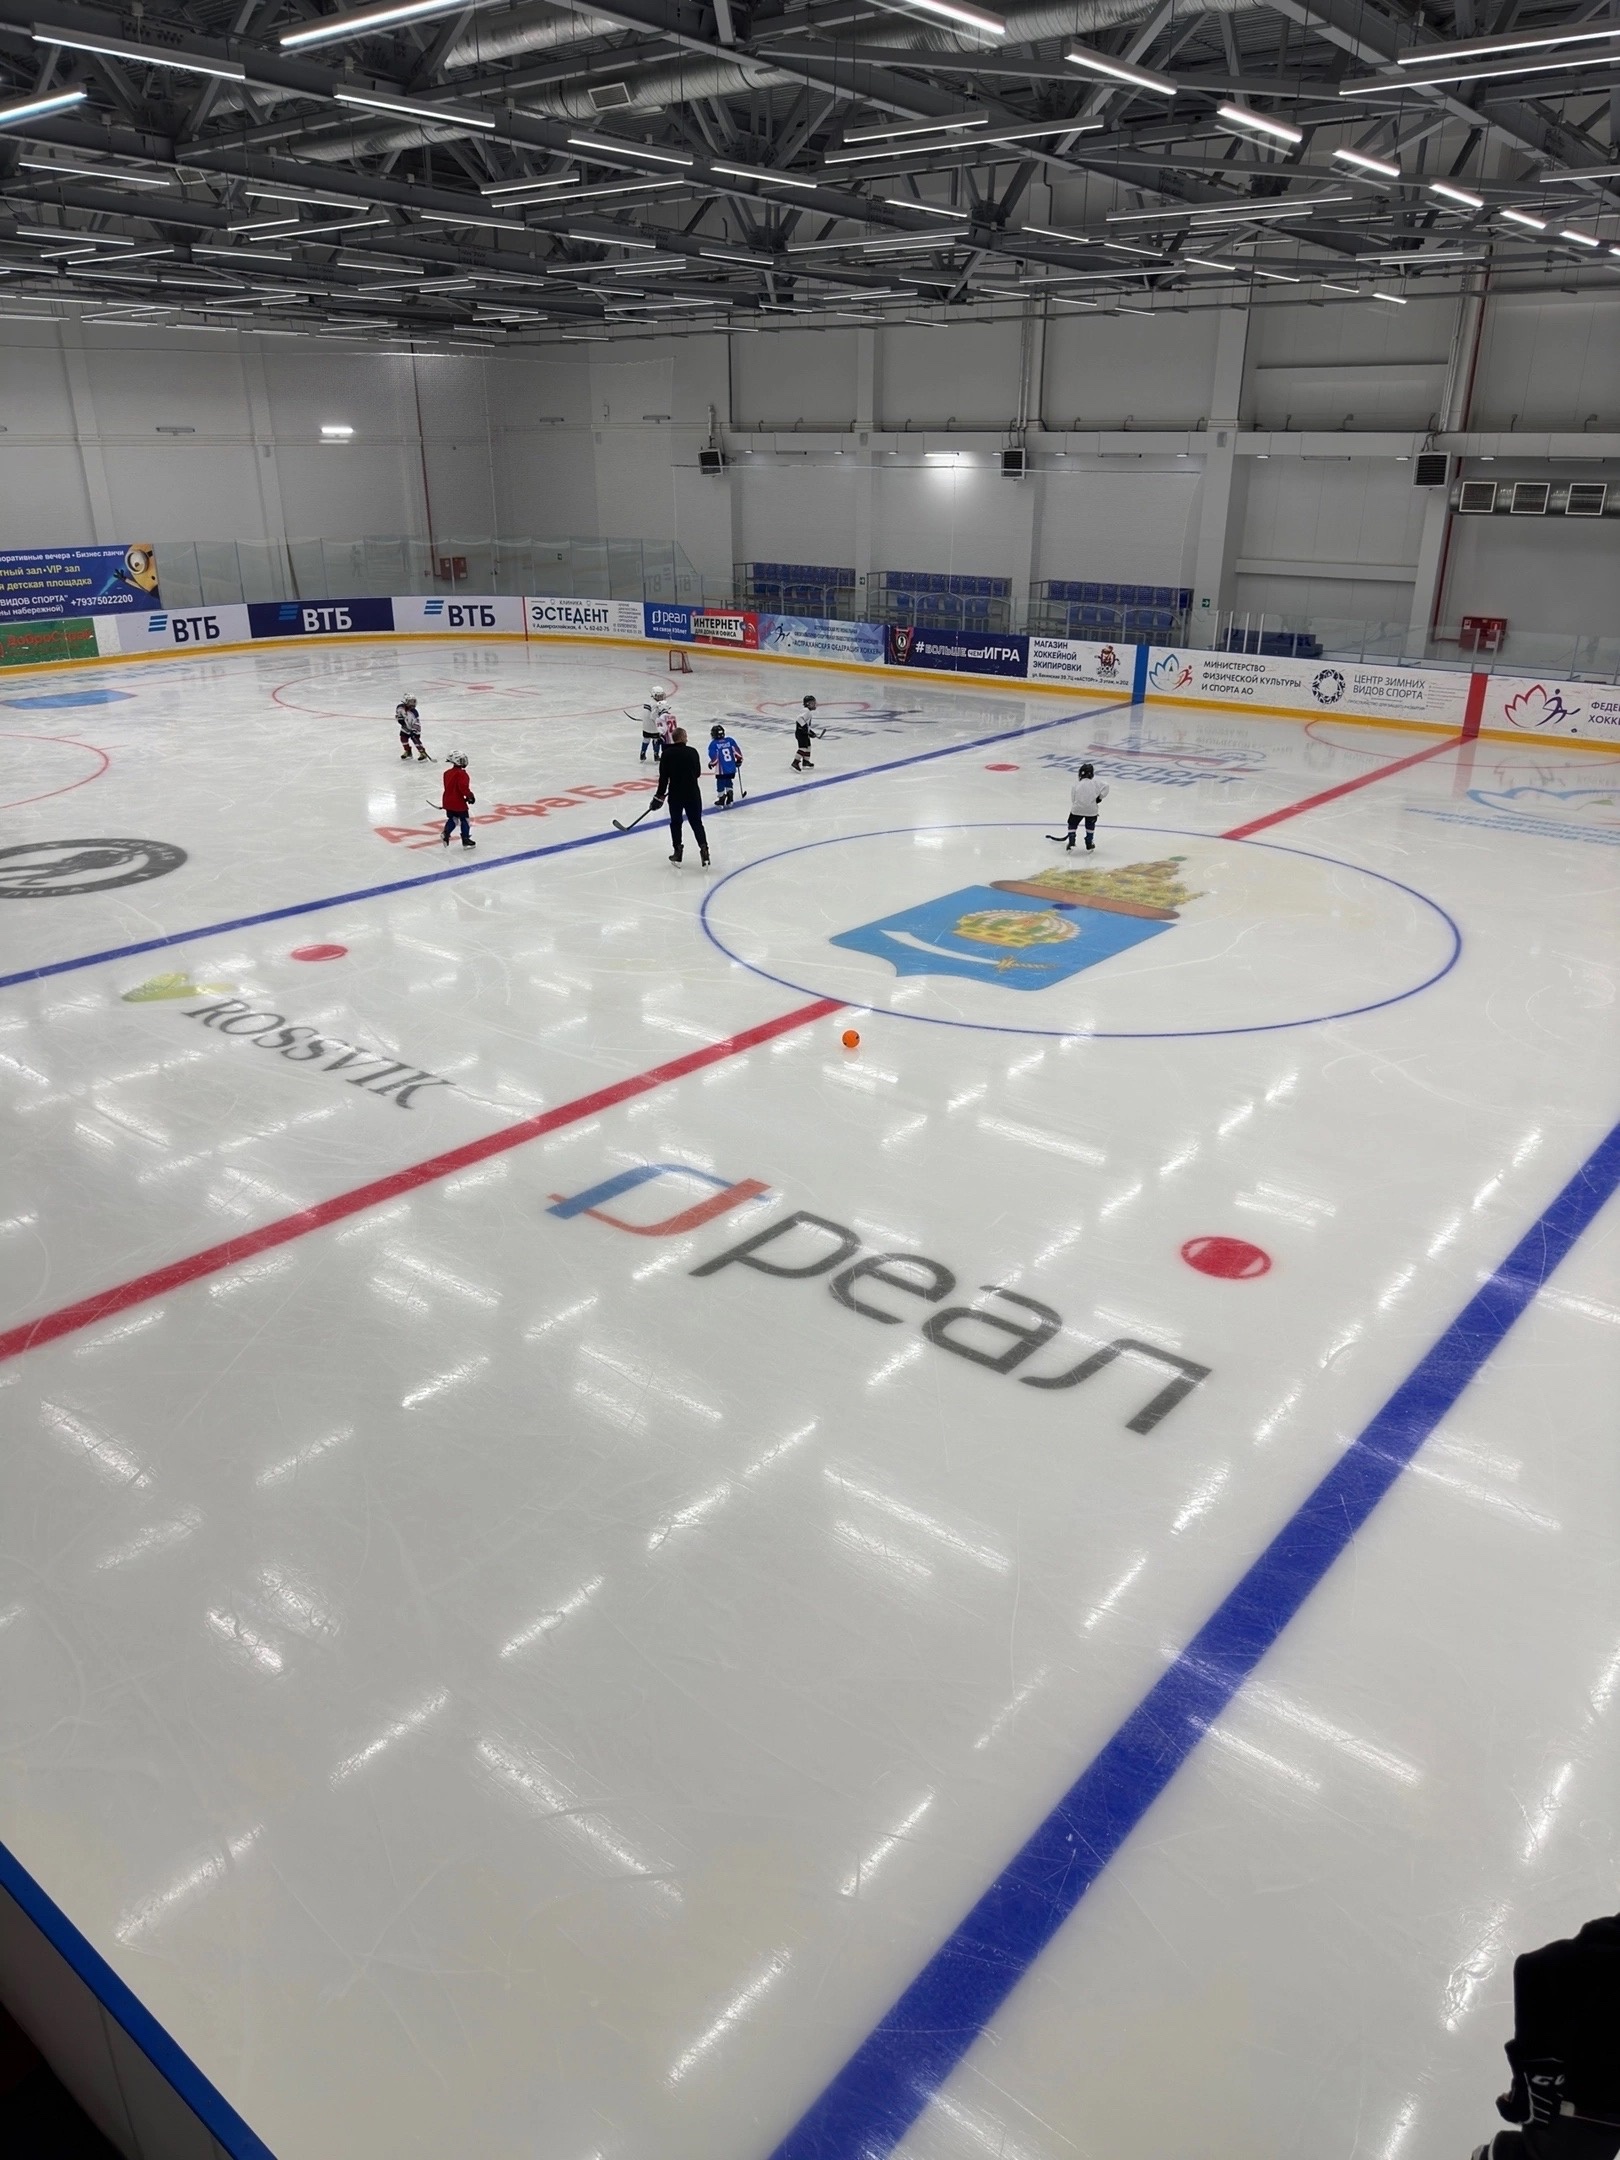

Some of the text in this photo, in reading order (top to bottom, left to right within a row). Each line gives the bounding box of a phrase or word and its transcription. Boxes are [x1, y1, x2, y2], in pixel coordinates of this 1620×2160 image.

[46, 565, 62, 574] VIP
[65, 565, 80, 573] зал
[7, 581, 44, 591] детская
[46, 578, 92, 588] площадка
[71, 594, 133, 606] +79375022200
[13, 604, 64, 616] набережной)
[448, 605, 496, 627] ВТБ
[532, 606, 608, 624] ЭСТЕДЕНТ
[302, 607, 352, 632] ВТБ
[662, 611, 687, 625] реал
[694, 618, 739, 630] ИНТЕРНЕТ
[172, 615, 220, 643] ВТБ
[831, 643, 859, 653] ФЕДЕРАЦИЯ
[1034, 640, 1068, 649] МАГАЗИН
[984, 646, 1020, 662] ИГРА
[1033, 650, 1076, 660] ХОККЕЙНОЙ
[1033, 661, 1082, 672] ЭКИПИРОВКИ
[1203, 661, 1266, 673] МИНИСТЕРСТВО
[1202, 671, 1302, 688] ФИЗИЧЕСКОЙ КУЛЬТУРЫ
[1354, 674, 1426, 689] ЦЕНТР ЗИМНИХ
[1209, 684, 1240, 694] СПОРТА
[1241, 687, 1254, 695] АО
[1353, 685, 1423, 699] ВИДОВ СПОРТА
[1591, 701, 1620, 712] ФЕДЕ
[1588, 714, 1620, 725] ХОКК
[722, 748, 732, 762] 8
[1037, 753, 1244, 783] МИНСПОРТ
[2, 886, 87, 897] ЛИГА
[181, 997, 456, 1110] ROSSVIK
[688, 1211, 1212, 1435] реал
